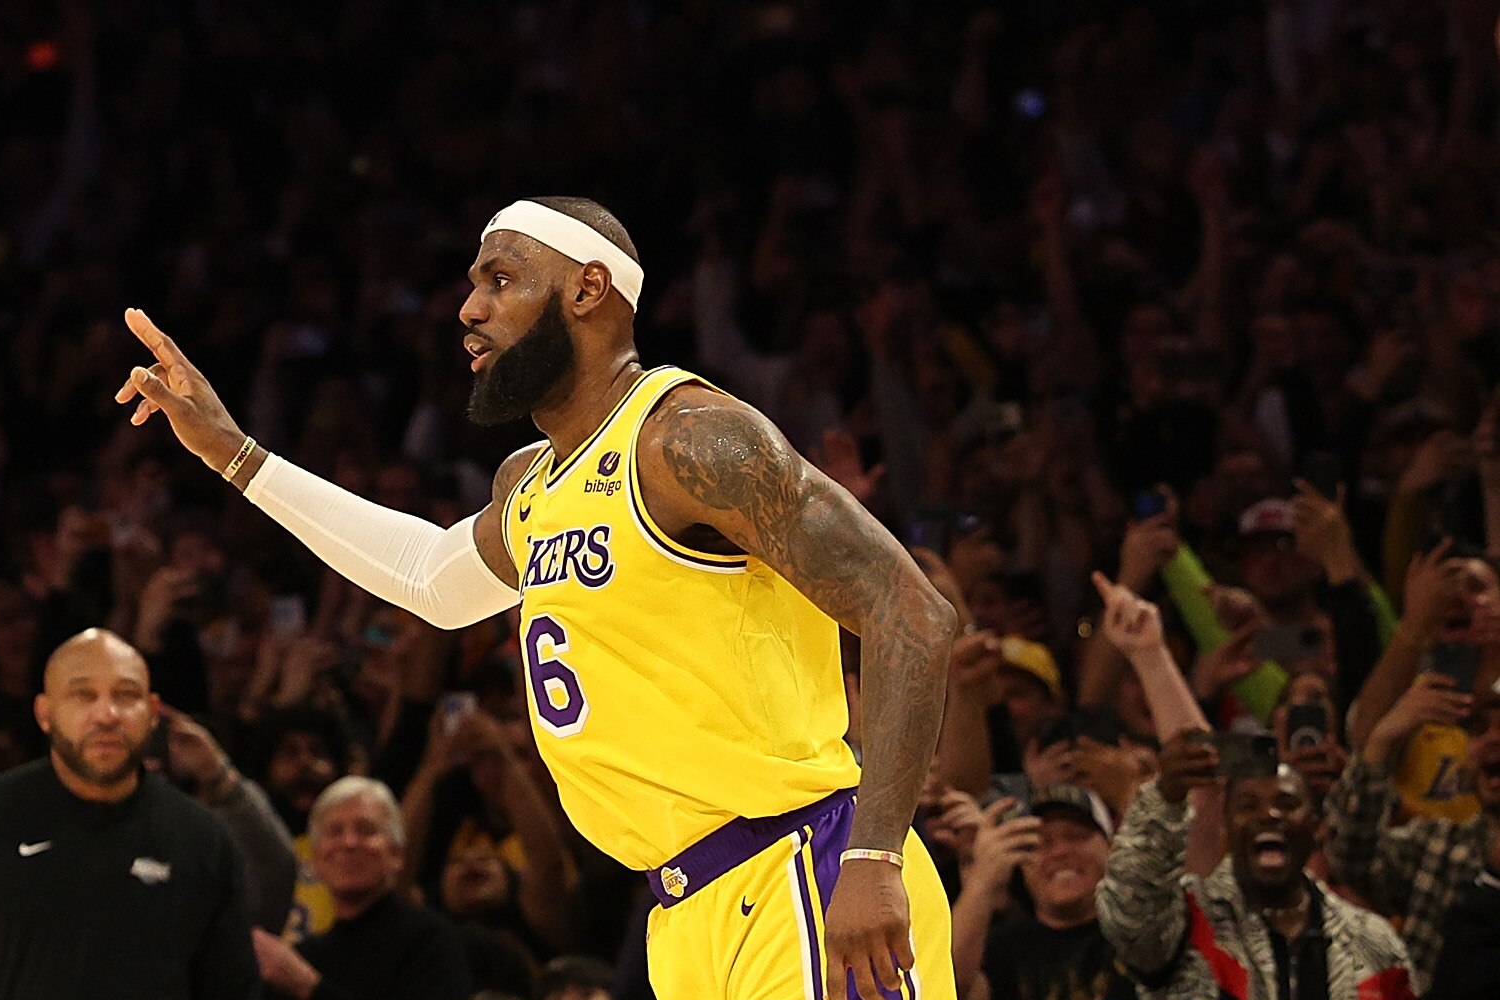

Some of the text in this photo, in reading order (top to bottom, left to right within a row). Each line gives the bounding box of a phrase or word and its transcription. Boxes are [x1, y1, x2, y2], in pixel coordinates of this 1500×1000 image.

[583, 479, 622, 497] bibigo
[524, 525, 614, 588] KERS
[523, 612, 590, 738] 6
